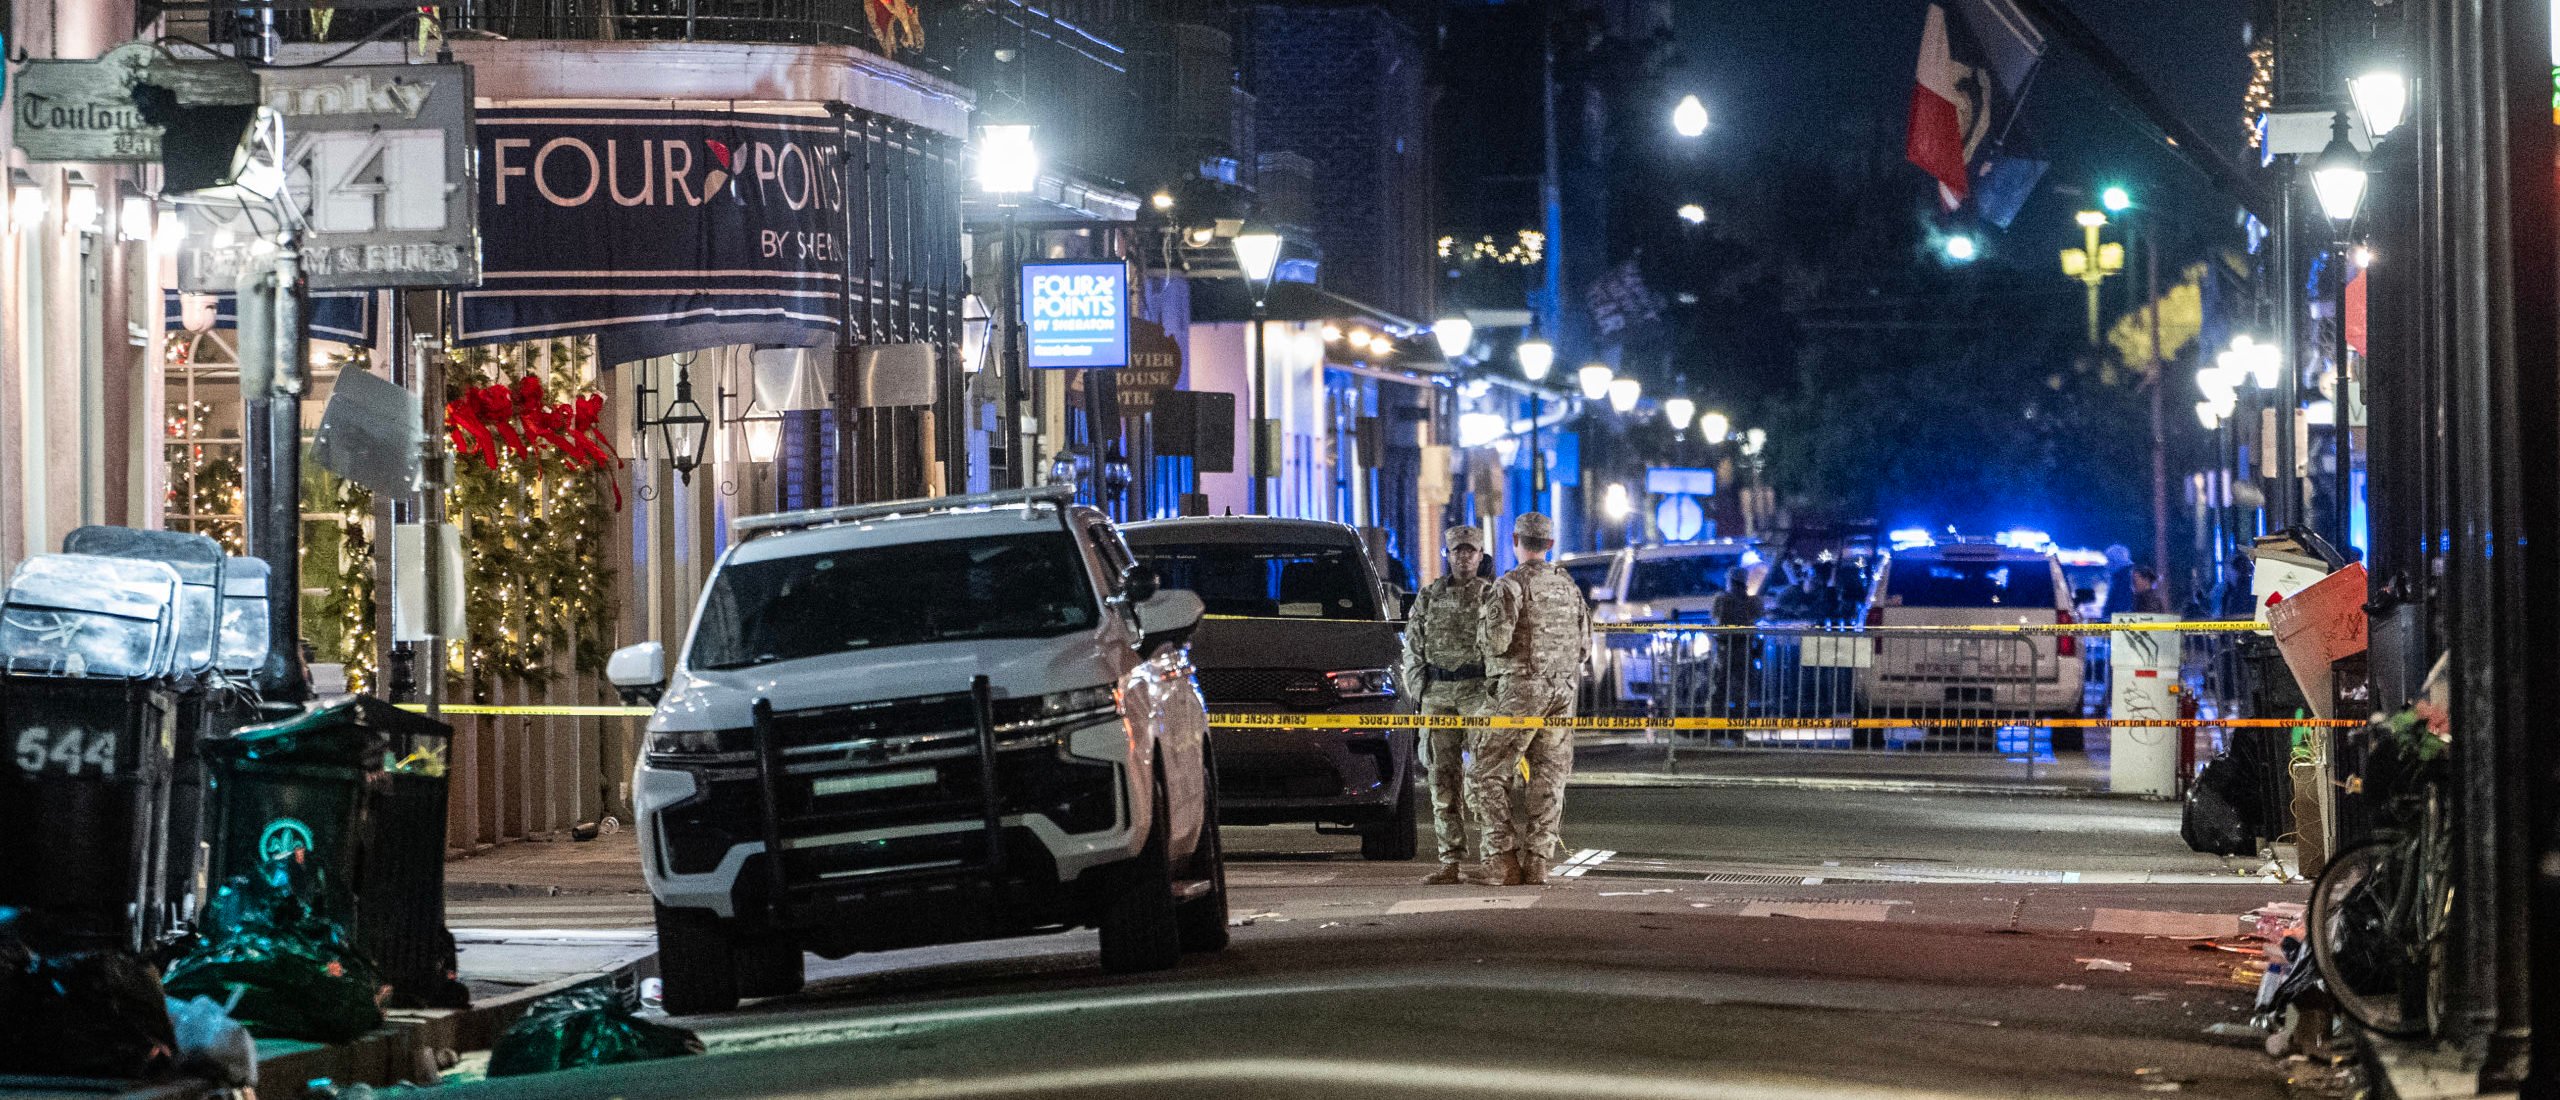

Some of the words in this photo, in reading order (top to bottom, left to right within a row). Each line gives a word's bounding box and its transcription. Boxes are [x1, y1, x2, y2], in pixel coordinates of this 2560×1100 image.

[262, 74, 436, 119] unky
[23, 92, 145, 130] Toulous
[495, 137, 702, 207] FOUR
[761, 229, 790, 258] BY
[1032, 275, 1096, 297] FOUR
[1032, 295, 1116, 318] POINTS
[1033, 319, 1050, 332] BY
[1130, 353, 1175, 368] VIER
[1209, 715, 1227, 725] NOT
[1229, 715, 1242, 725] DO
[1243, 715, 1274, 725] SCENE
[1276, 715, 1307, 725] CRIME
[1359, 716, 1389, 726] CROSS
[1392, 716, 1410, 726] NOT
[1412, 716, 1426, 726] DO
[1428, 716, 1458, 726] SCENE
[1460, 716, 1490, 726] CRIME
[1542, 717, 1573, 727] CROSS
[1576, 717, 1593, 727] NOT
[1597, 717, 1609, 727] DO
[1613, 717, 1643, 727] SCENE
[1645, 717, 1675, 727] CRIME
[1727, 718, 1757, 728] CROSS
[1760, 718, 1778, 728] NOT
[1780, 718, 1794, 728] DO
[1796, 718, 1827, 728] SCENE
[1828, 718, 1859, 728] CRIME
[16, 727, 117, 775] 544
